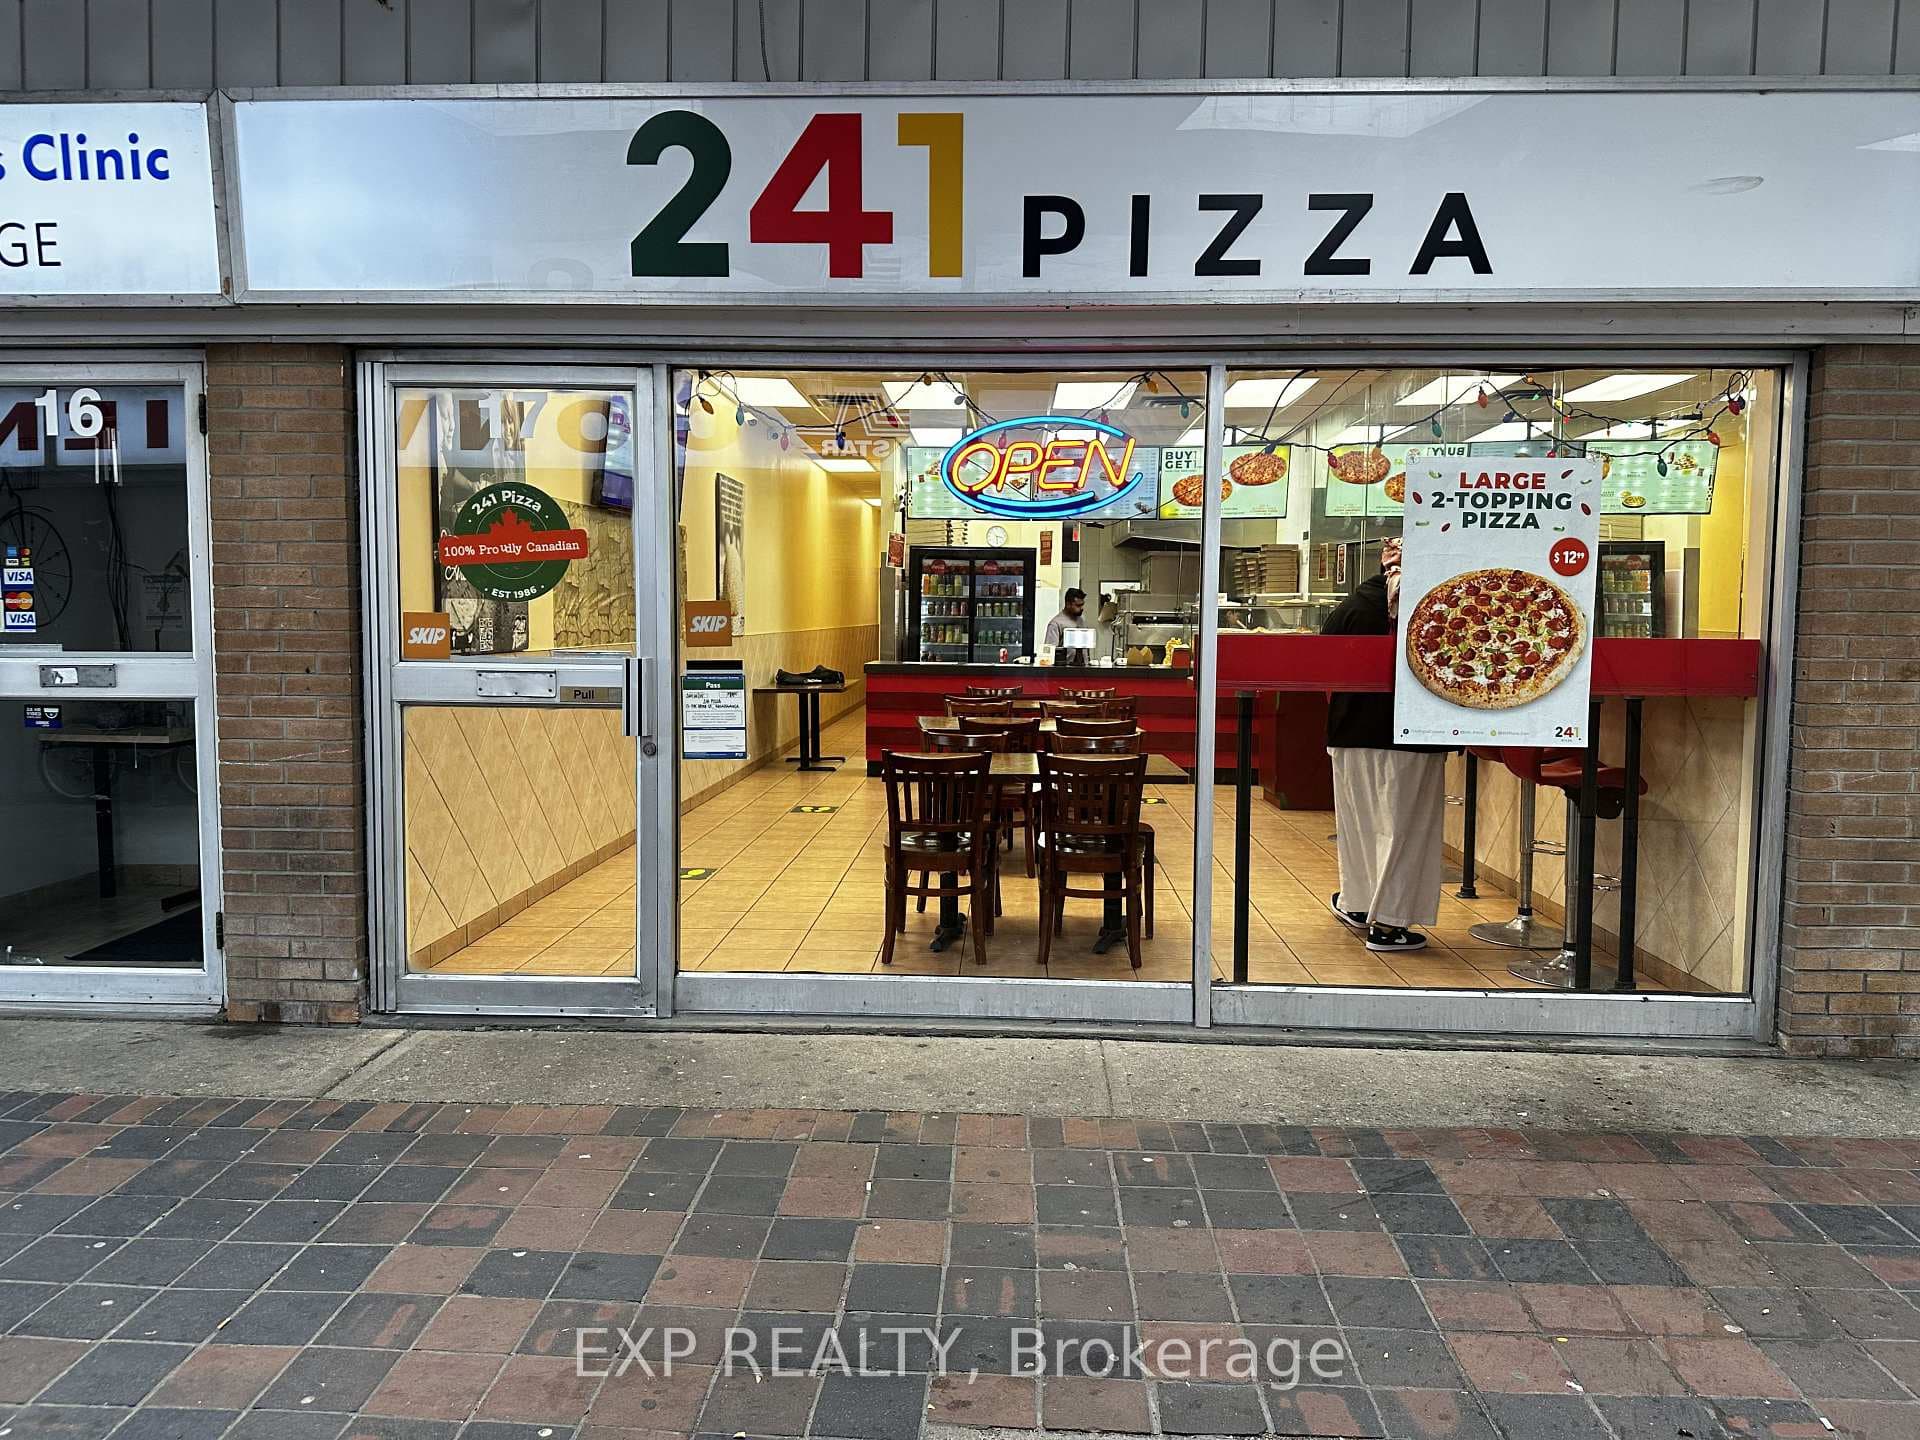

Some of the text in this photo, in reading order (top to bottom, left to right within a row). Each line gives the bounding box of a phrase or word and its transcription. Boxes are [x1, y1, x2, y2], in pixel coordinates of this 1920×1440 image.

[22, 132, 170, 181] Clinic
[626, 109, 1493, 279] 241 PIZZA
[35, 387, 104, 437] 16
[478, 391, 548, 439] 17
[1165, 450, 1193, 460] BUY
[951, 437, 1137, 493] OPEN
[1165, 460, 1193, 469] GET
[1459, 472, 1546, 490] LARGE
[471, 490, 543, 516] 241 Pizza
[1431, 491, 1573, 510] 2-TOPPING
[1461, 511, 1541, 529] PIZZA
[443, 539, 580, 557] 100% Proudly Canadian
[6, 571, 33, 582] VISA
[491, 585, 537, 599] EST 1986
[9, 613, 35, 624] VISA
[689, 614, 728, 633] SKIP
[408, 626, 446, 645] SKIP
[705, 681, 721, 689] Pass
[573, 689, 595, 700] Pull
[1554, 726, 1581, 738] 241
